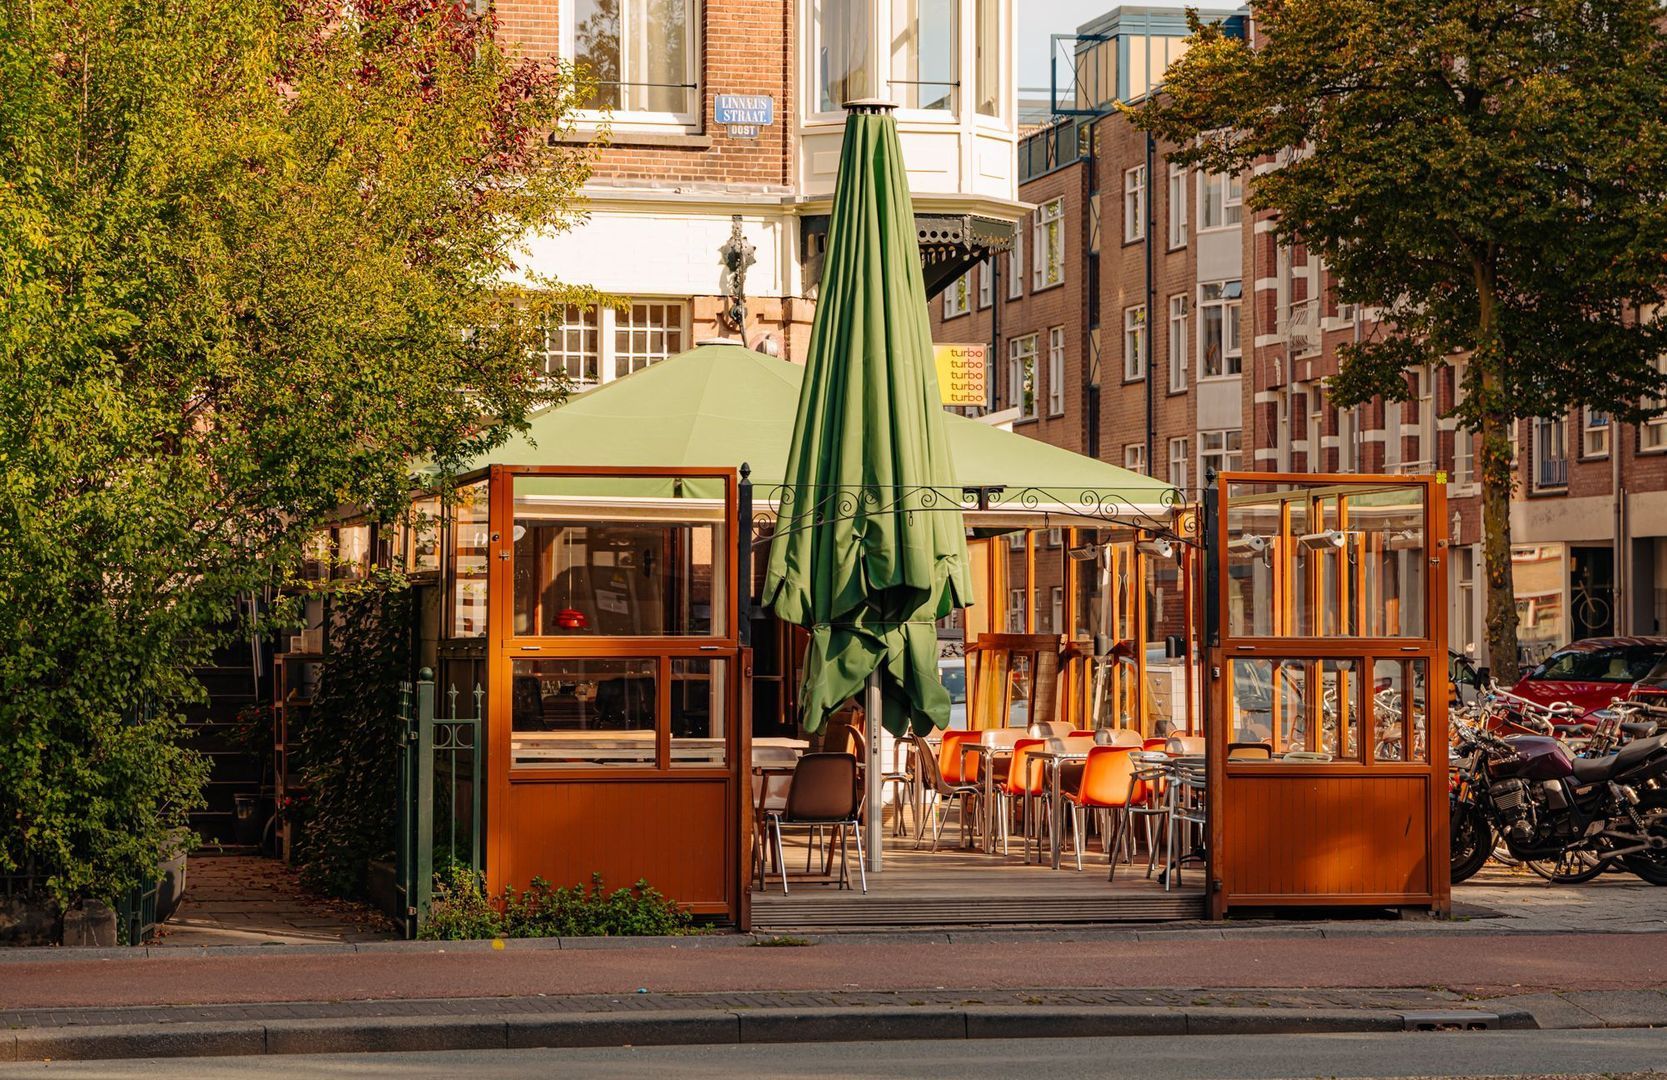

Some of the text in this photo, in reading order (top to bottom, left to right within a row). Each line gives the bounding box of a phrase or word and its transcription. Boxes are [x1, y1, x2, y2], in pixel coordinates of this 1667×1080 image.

[731, 125, 755, 135] OOST
[951, 348, 983, 357] turbo
[951, 359, 983, 368] turbo
[951, 370, 983, 379] turbo
[951, 381, 983, 390] turbo
[951, 392, 983, 401] turbo
